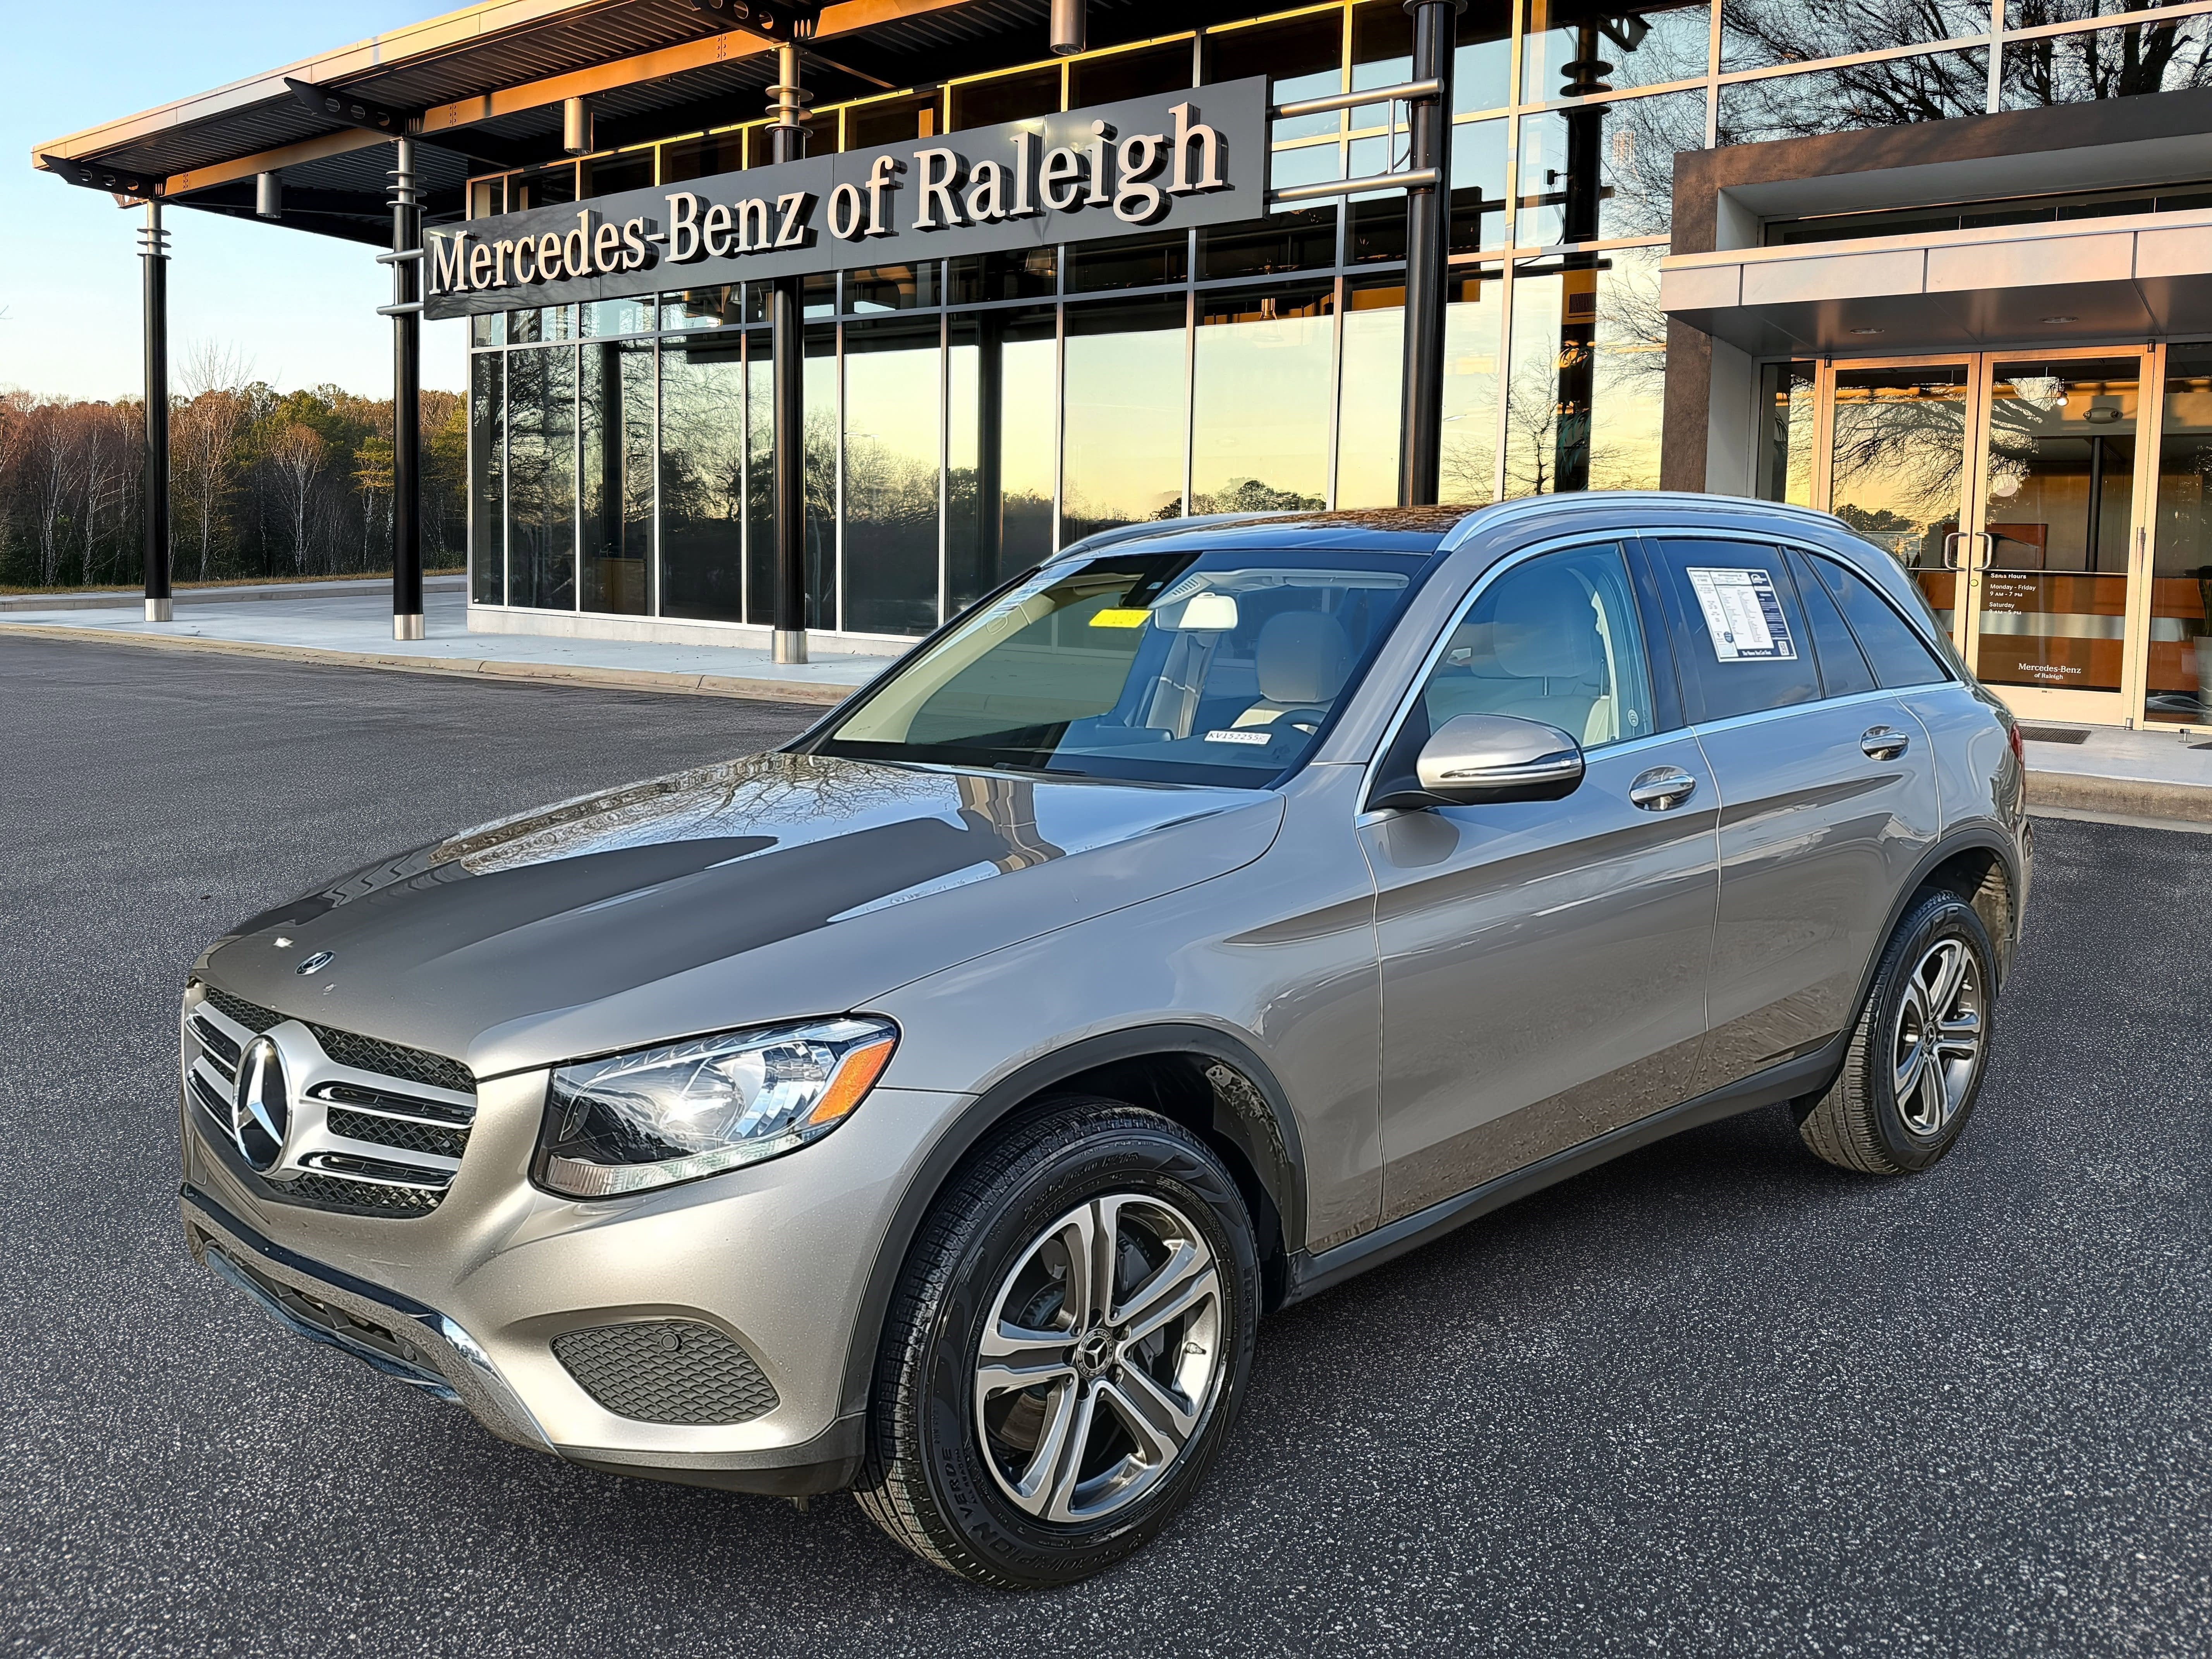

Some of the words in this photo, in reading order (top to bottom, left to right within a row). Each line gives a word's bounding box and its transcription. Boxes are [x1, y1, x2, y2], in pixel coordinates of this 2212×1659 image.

[429, 191, 805, 295] Mercedes-Benz
[827, 155, 894, 239] of
[912, 101, 1224, 228] Raleigh
[2018, 663, 2081, 674] Mercedes-Benz
